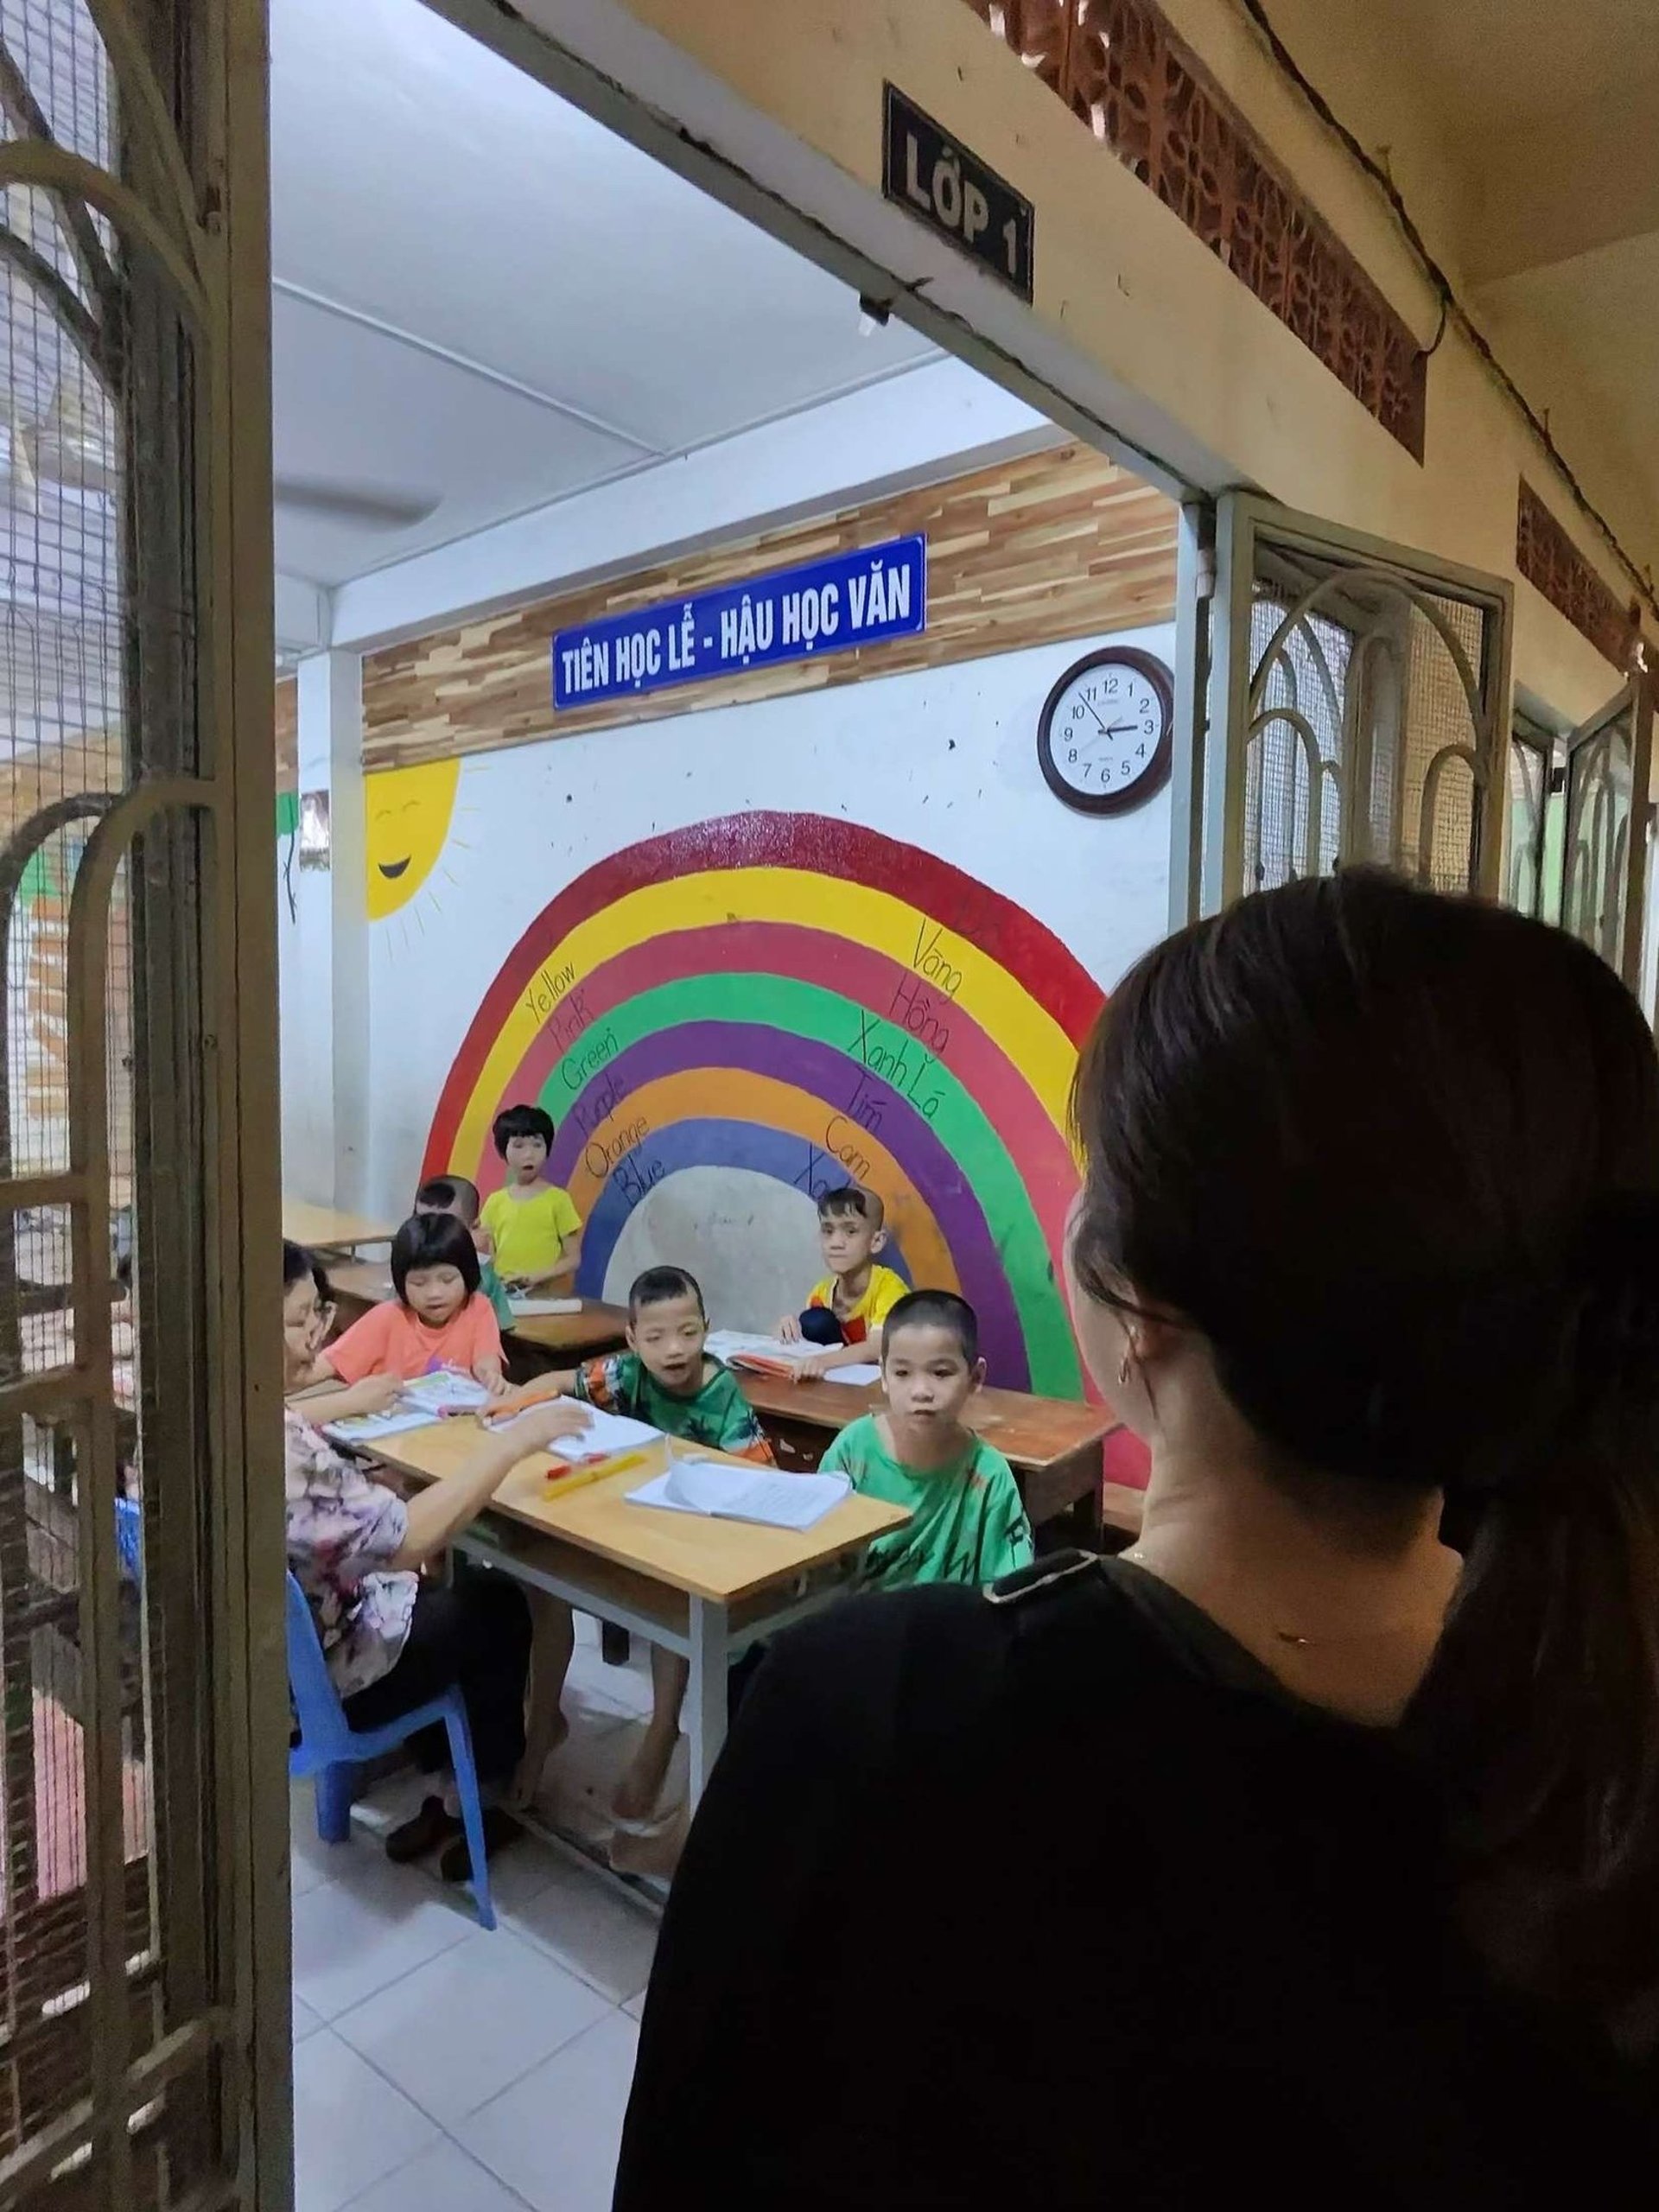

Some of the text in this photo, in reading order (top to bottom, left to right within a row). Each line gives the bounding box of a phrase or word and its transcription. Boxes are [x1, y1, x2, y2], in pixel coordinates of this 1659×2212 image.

[906, 134, 1017, 275] LỚP 1
[563, 636, 609, 694] TIÊN
[615, 629, 661, 689] HỌC
[668, 602, 696, 671] LỄ
[720, 594, 774, 664] HẬU
[781, 583, 839, 651] HỌC
[848, 560, 912, 630] VĂN
[1103, 678, 1119, 694] 12
[1127, 682, 1134, 697] 1
[1086, 687, 1097, 702] 11
[1071, 705, 1085, 720] 10
[1139, 698, 1150, 714] 2
[1064, 728, 1073, 741] 9
[1143, 720, 1154, 734] 3
[1068, 749, 1077, 763] 8
[1135, 743, 1146, 758] 4
[1083, 763, 1092, 778] 7
[1101, 768, 1111, 783] 6
[1121, 760, 1131, 775] 5
[525, 962, 575, 1024] Yellow
[888, 974, 950, 1064] Hồng
[847, 1009, 907, 1087] Xanh
[561, 1027, 620, 1090] Green
[847, 1065, 887, 1129] Tím
[585, 1116, 649, 1179] Orange
[825, 1115, 871, 1181] Cam
[613, 1154, 665, 1207] Blue
